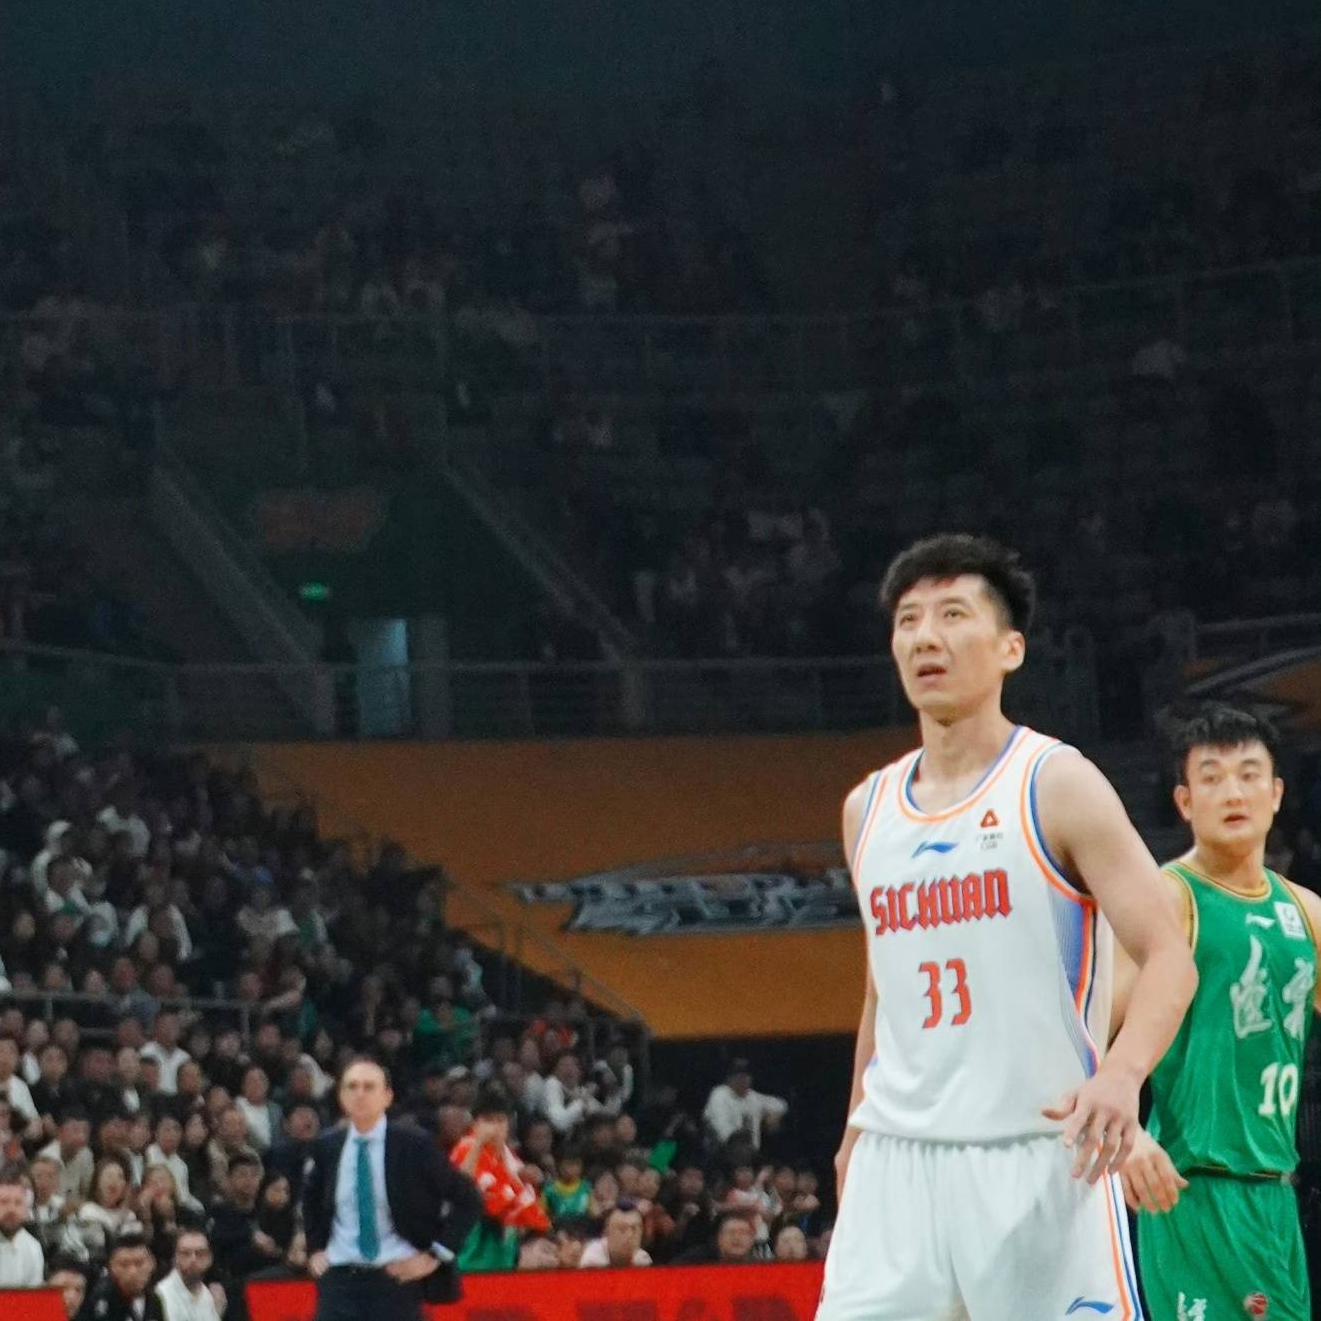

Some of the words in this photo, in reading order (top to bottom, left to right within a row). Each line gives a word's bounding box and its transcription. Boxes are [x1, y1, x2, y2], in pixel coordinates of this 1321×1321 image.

[870, 868, 1012, 937] SICHUAN
[918, 958, 972, 1029] 33
[1258, 1061, 1299, 1117] 10
